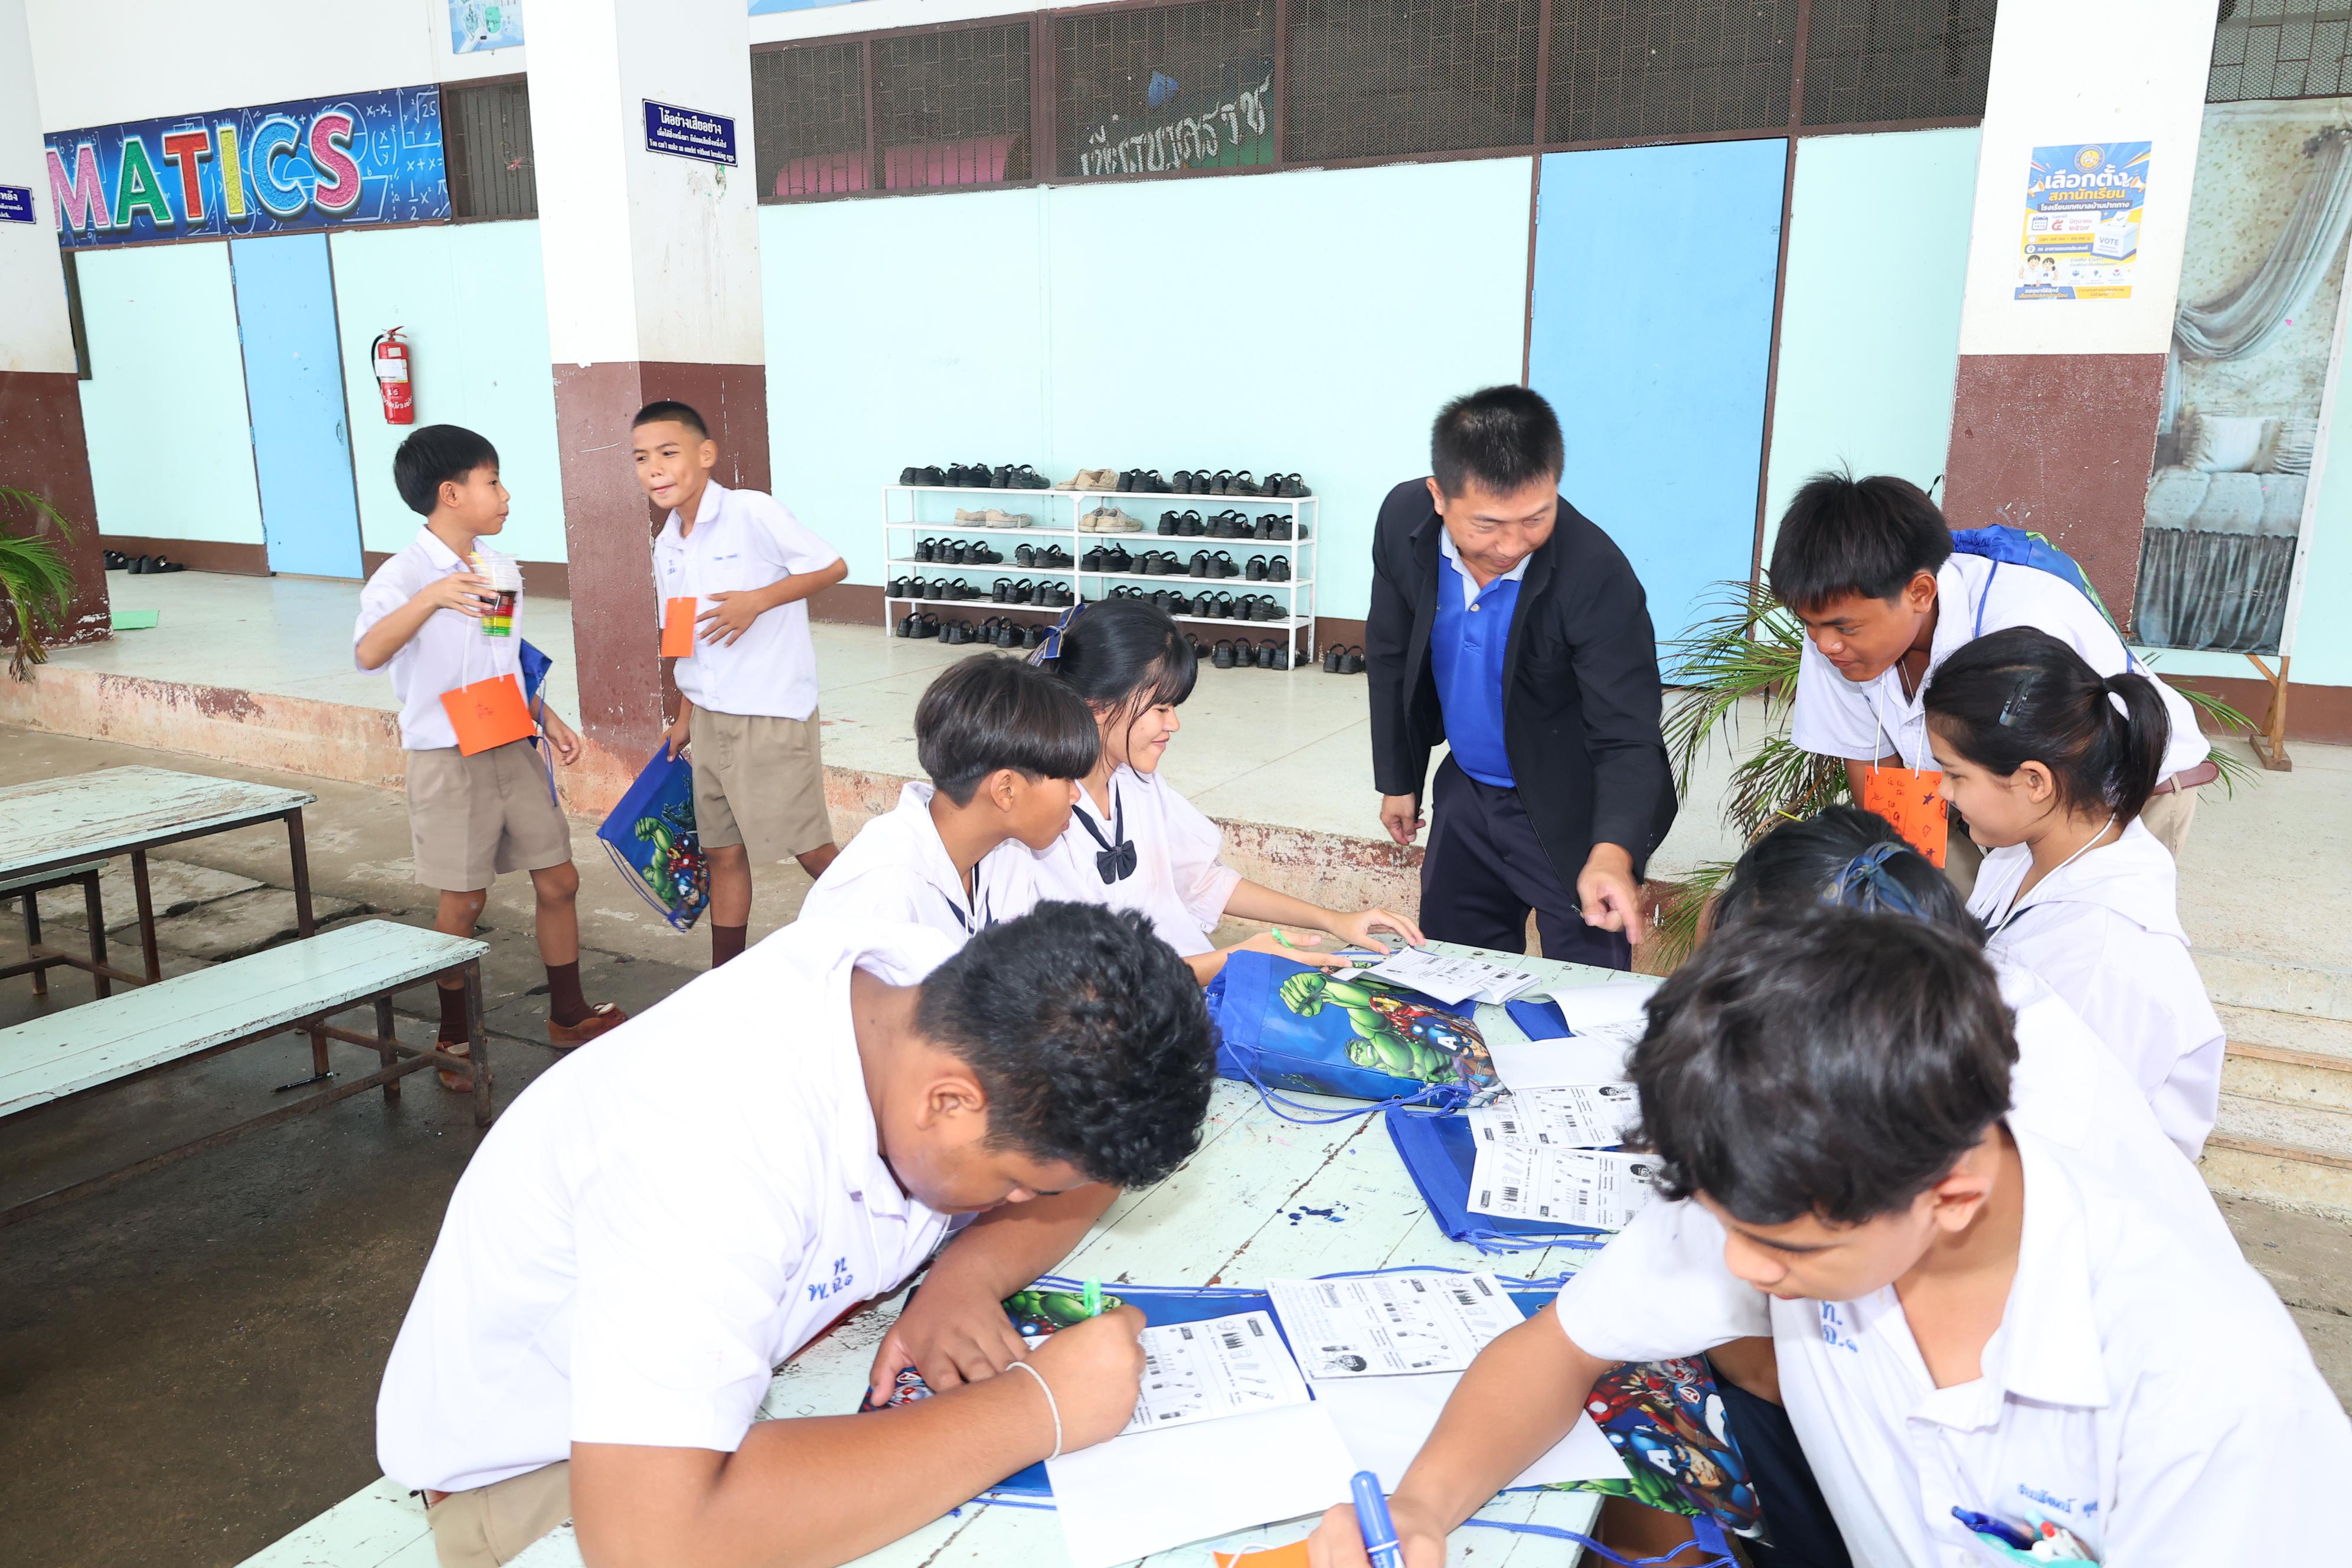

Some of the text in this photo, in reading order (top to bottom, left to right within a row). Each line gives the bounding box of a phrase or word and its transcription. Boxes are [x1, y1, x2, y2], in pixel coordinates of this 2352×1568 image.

[658, 107, 722, 135] ได้อย่างเสียอย่าง
[649, 138, 658, 147] You
[658, 141, 667, 149] can't
[668, 143, 678, 151] make
[697, 148, 711, 156] without
[711, 150, 727, 161] breaking
[2044, 164, 2130, 189] เลือกตั้ง
[2049, 187, 2125, 201] สภานักเรียน
[2041, 202, 2129, 211] โรงเรียนเทศบาลบ้านปากทาง
[2052, 219, 2064, 231] ๕
[2099, 237, 2119, 246] VOTE
